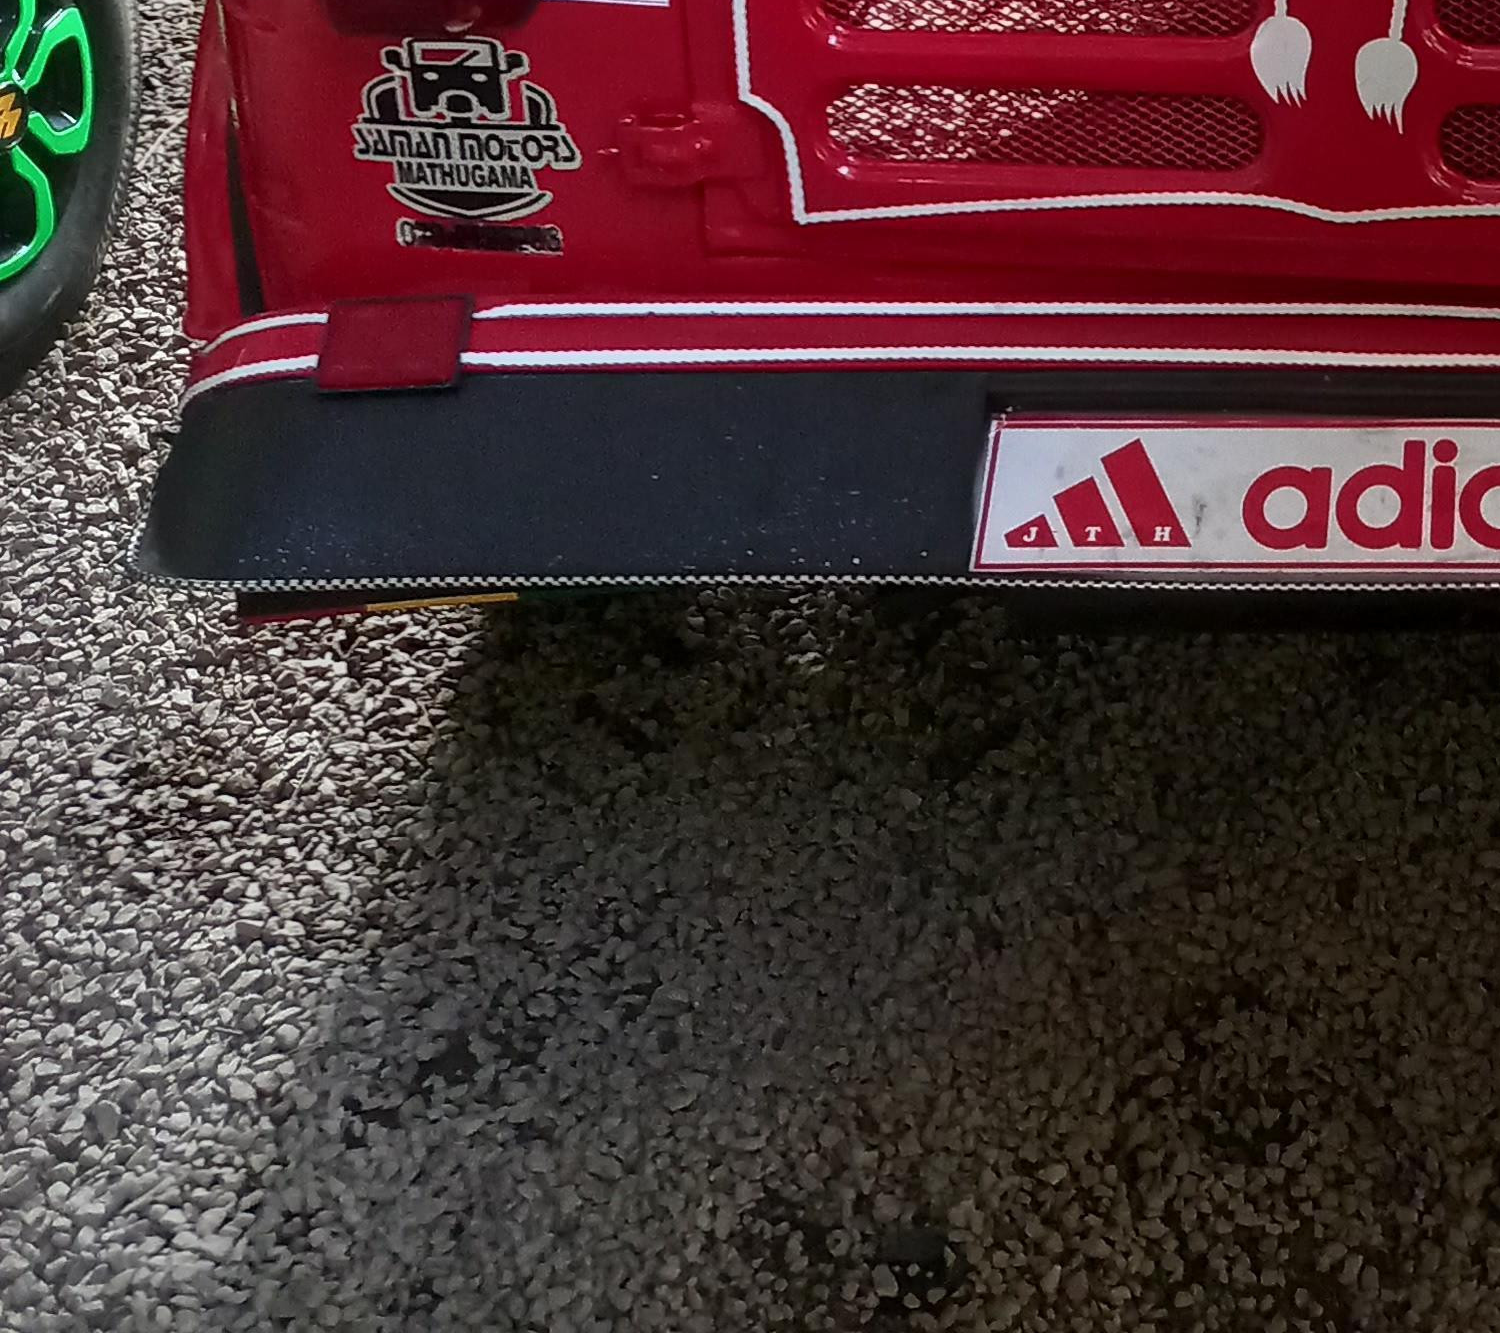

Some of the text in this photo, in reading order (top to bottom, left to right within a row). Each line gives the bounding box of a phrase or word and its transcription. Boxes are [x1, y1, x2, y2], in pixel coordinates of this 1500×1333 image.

[397, 160, 534, 189] MATHUGAMA
[1022, 526, 1172, 543] J T H
